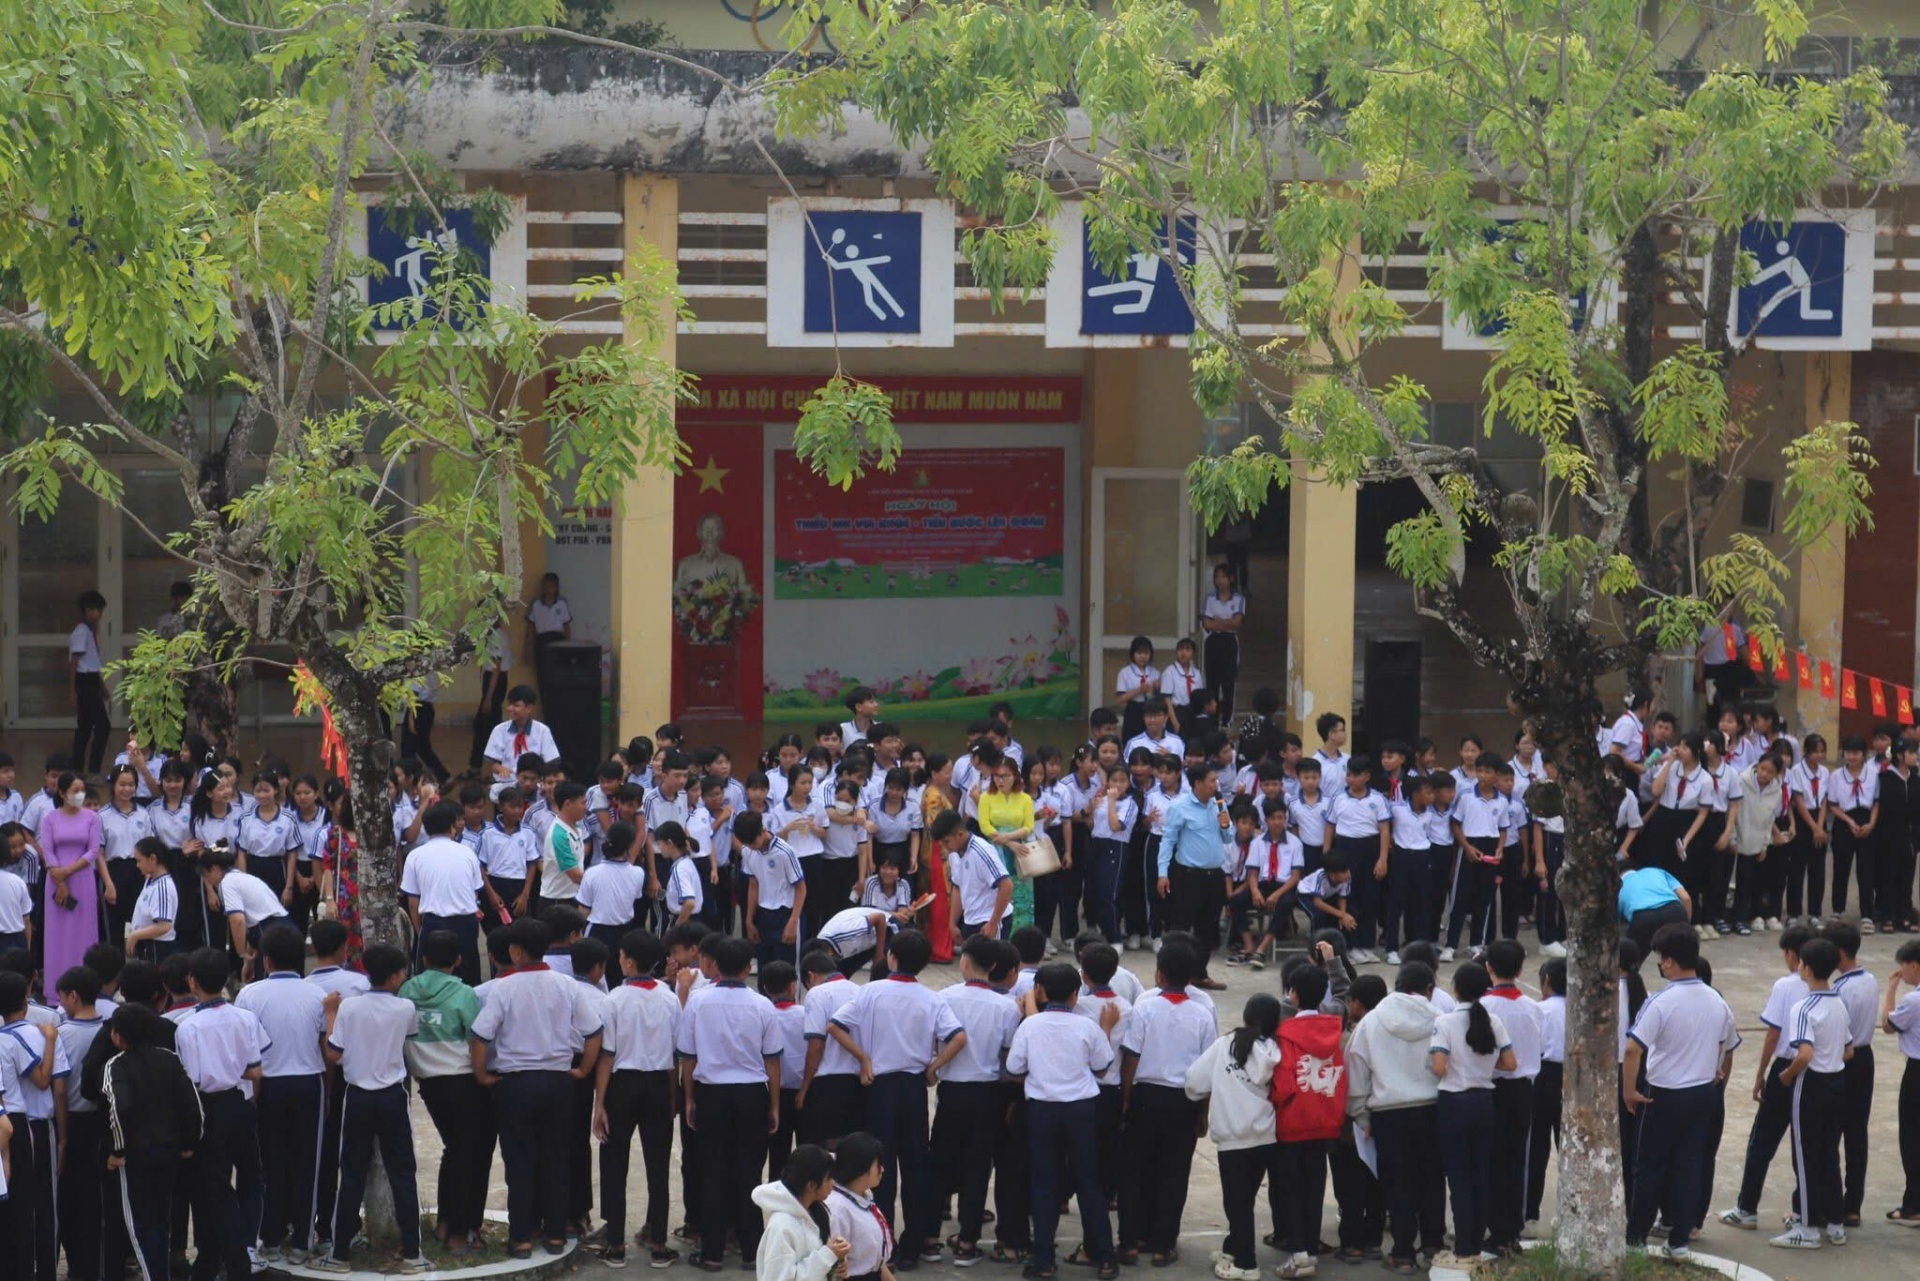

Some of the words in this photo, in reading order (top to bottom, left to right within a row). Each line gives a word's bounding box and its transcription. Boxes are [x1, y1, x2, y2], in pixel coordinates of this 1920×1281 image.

[925, 390, 963, 409] NAM
[968, 386, 1020, 410] MUÔN
[1025, 387, 1063, 409] NĂM
